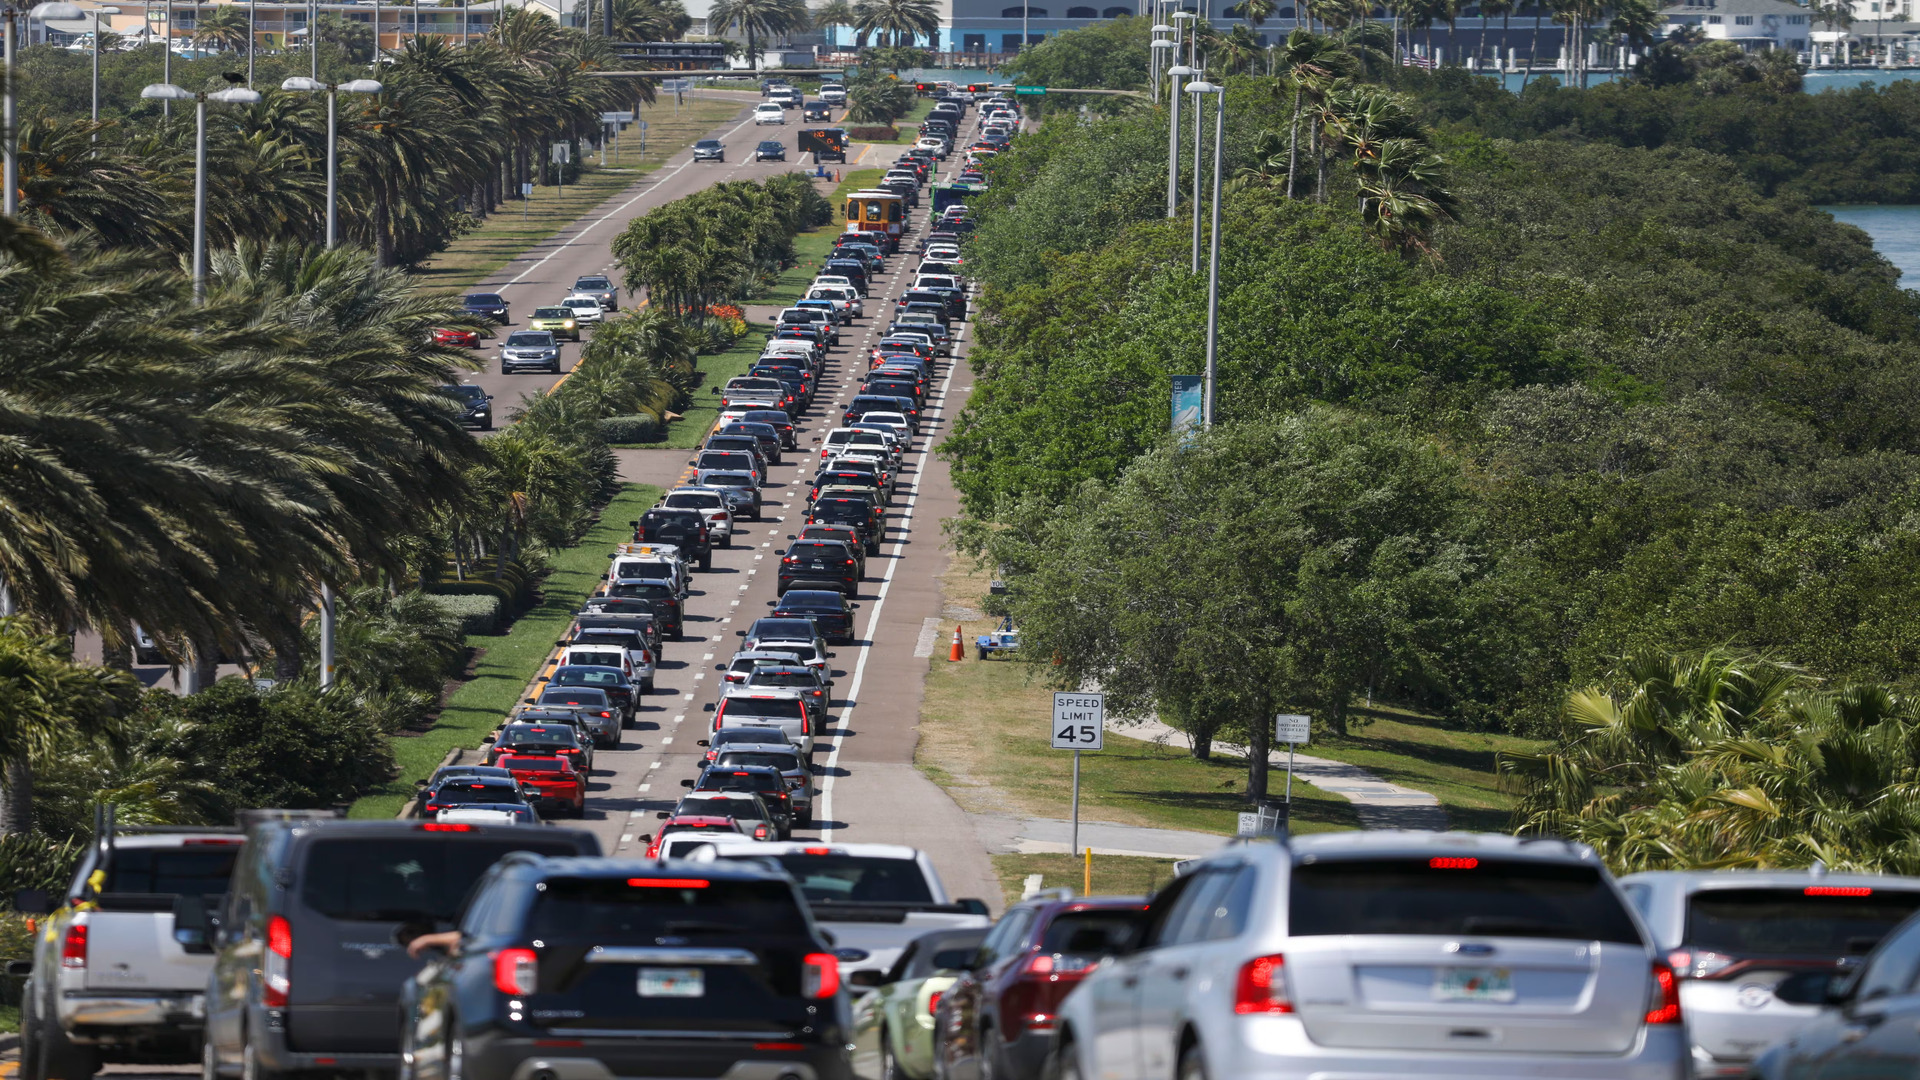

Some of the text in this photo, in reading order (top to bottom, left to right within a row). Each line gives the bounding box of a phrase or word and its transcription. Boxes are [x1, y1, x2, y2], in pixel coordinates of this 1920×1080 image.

[1174, 380, 1182, 412] WINTER
[1057, 698, 1100, 708] SPEED
[1061, 711, 1095, 721] LIMIT
[1057, 725, 1096, 744] 45
